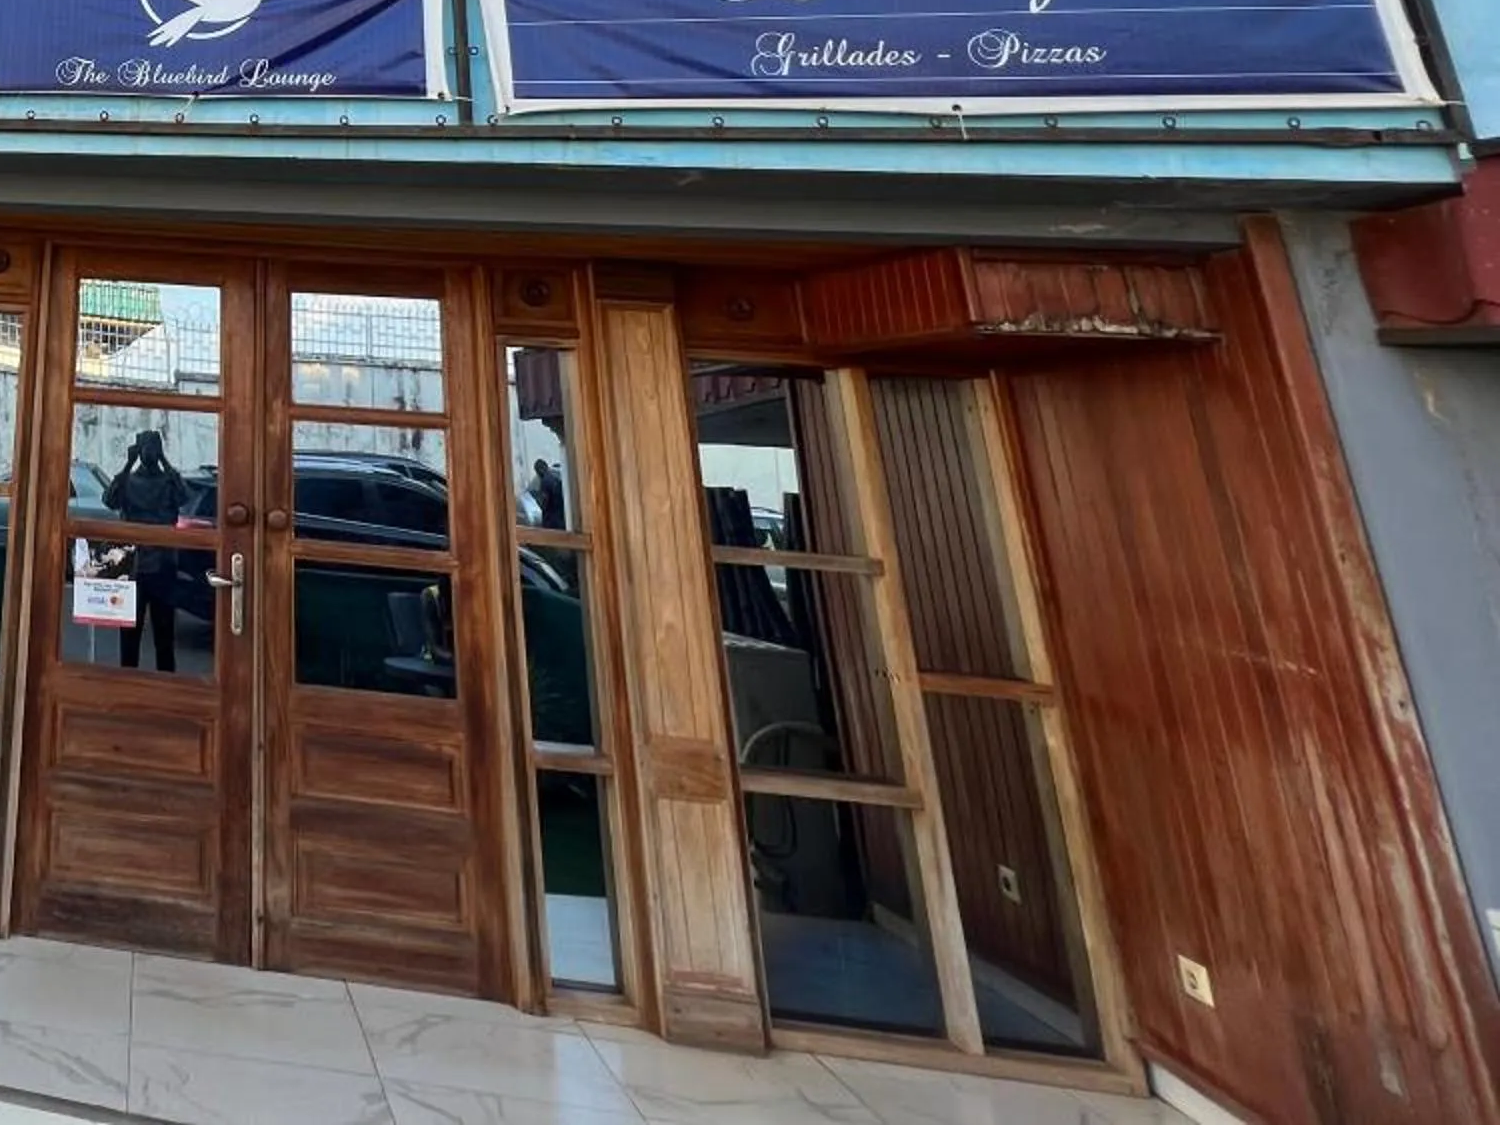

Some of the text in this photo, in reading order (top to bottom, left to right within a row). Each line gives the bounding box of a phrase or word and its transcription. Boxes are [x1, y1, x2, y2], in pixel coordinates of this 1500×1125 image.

[751, 31, 922, 77] Grillades
[967, 28, 1107, 68] Pizzas
[55, 56, 336, 93] The Bluebird Lounge
